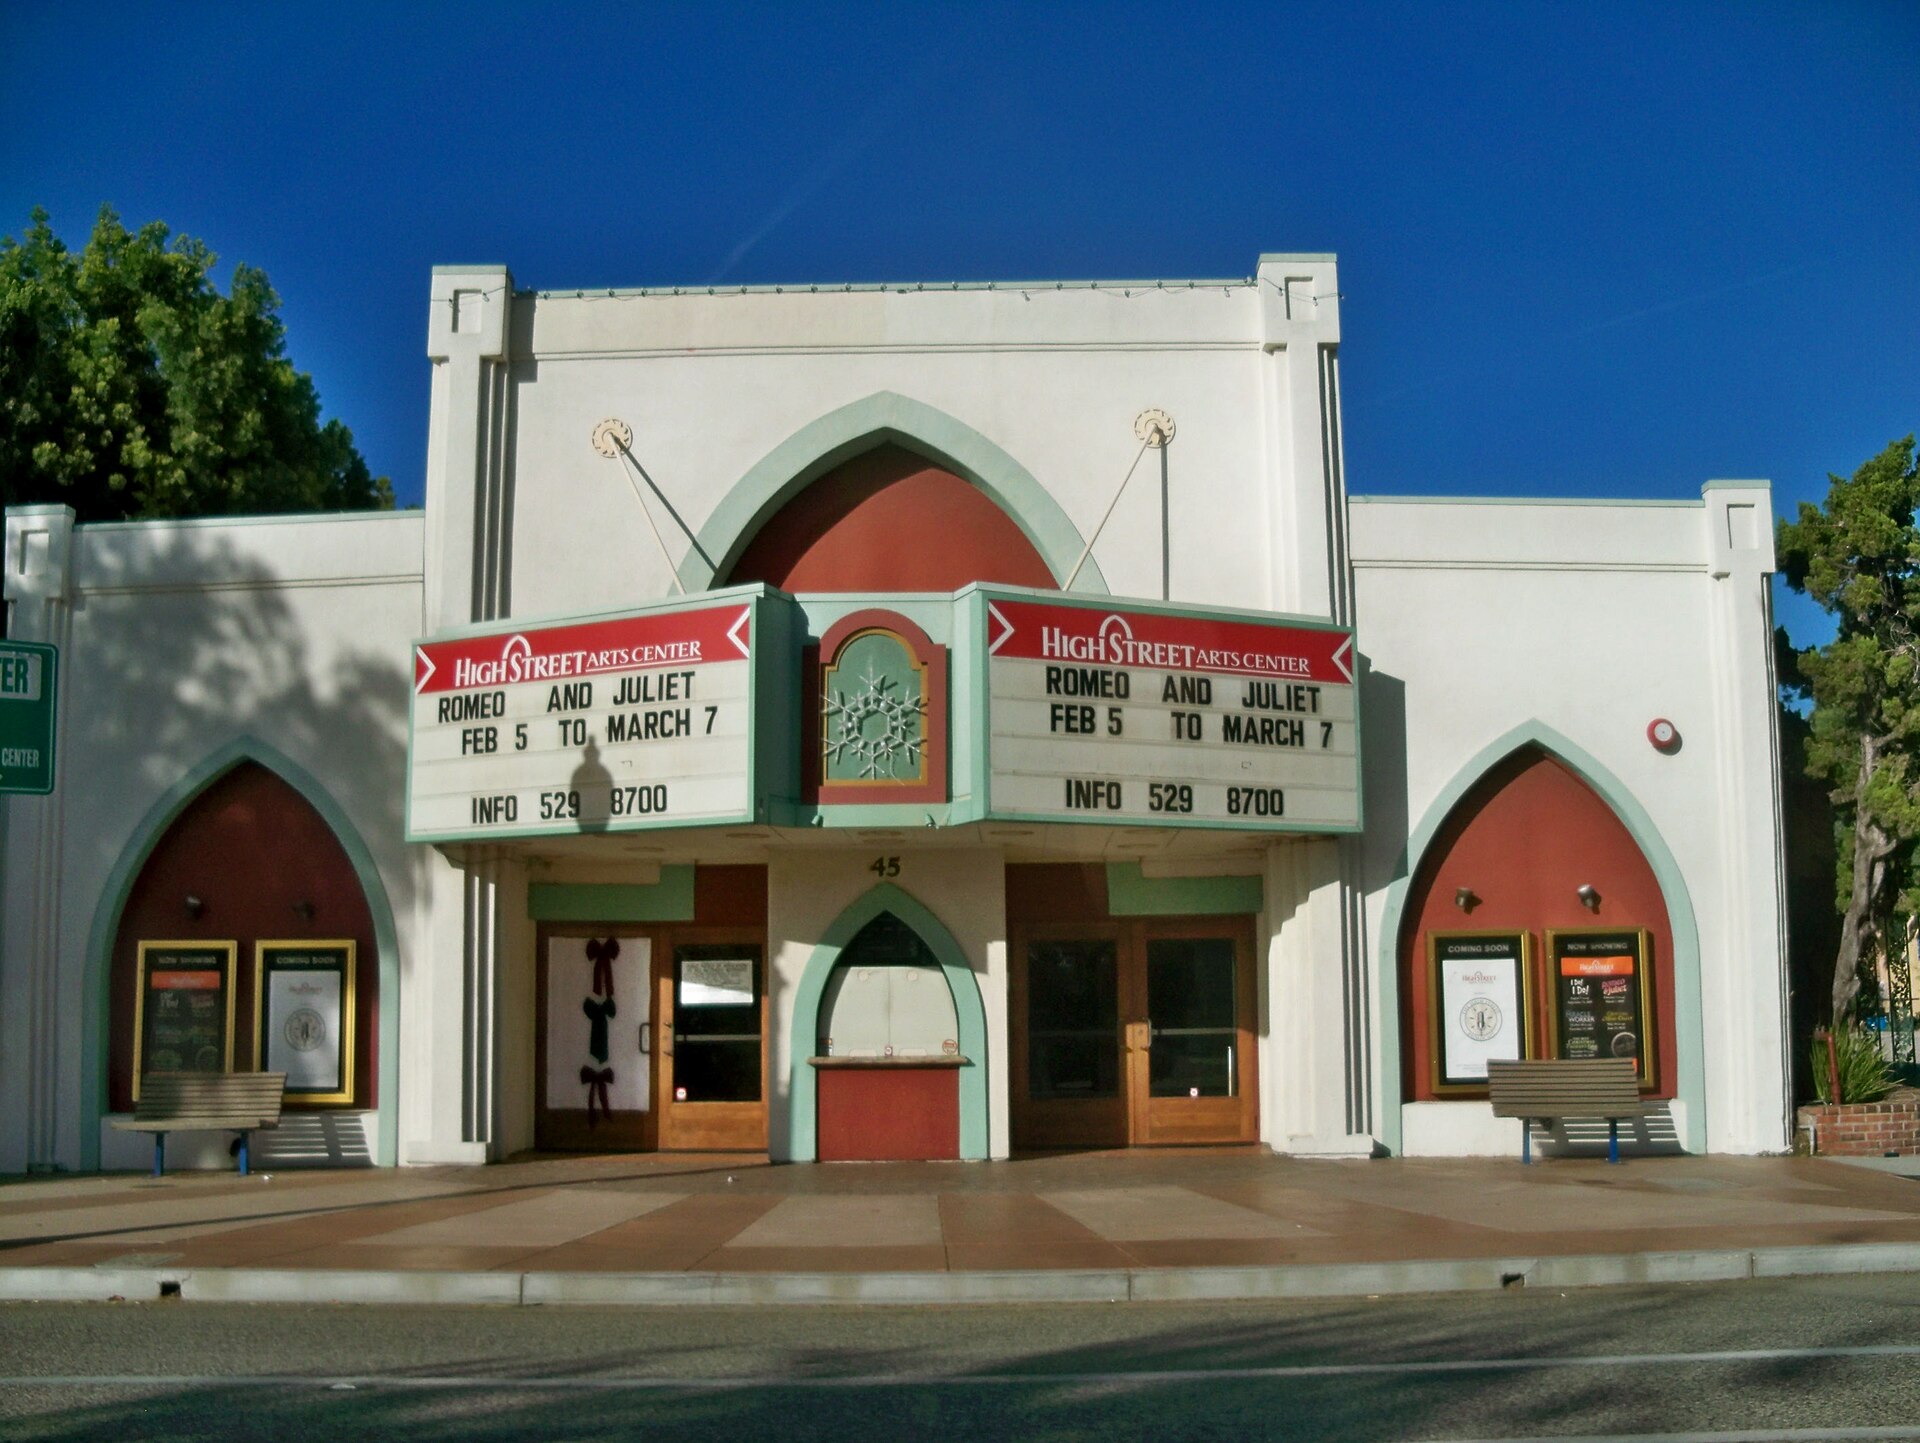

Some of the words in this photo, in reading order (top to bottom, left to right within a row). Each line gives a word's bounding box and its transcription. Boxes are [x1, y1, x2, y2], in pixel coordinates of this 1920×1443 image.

[586, 651, 629, 668] ARTS
[632, 640, 701, 662] CENTER
[1196, 651, 1240, 667] ARTS
[1243, 653, 1309, 673] CENTER
[0, 657, 29, 693] ER
[1046, 666, 1129, 699] ROMEO
[1162, 676, 1212, 705] AND
[1242, 682, 1321, 713] JULIET
[438, 691, 505, 723] ROMEO
[547, 682, 592, 713] AND
[613, 671, 695, 706] JULIET
[462, 726, 497, 755] FEB
[515, 724, 527, 751] 5
[558, 718, 586, 747] TO
[608, 707, 690, 742] MARCH
[705, 706, 718, 734] 7
[1051, 704, 1095, 734] FEB
[1108, 707, 1123, 735] 5
[1171, 712, 1202, 740] TO
[1223, 715, 1304, 748] MARCH
[1320, 722, 1333, 748] 7
[2, 748, 39, 768] CENTER
[472, 795, 517, 824] INFO
[540, 791, 580, 820] 529
[611, 784, 667, 814] 8700
[1066, 779, 1121, 810] INFO
[1149, 783, 1193, 813] 529
[1227, 787, 1284, 816] 8700
[870, 856, 901, 878] 45
[1448, 945, 1482, 953] COMING
[1590, 942, 1628, 950] SHOWING
[1577, 985, 1589, 995] Do!
